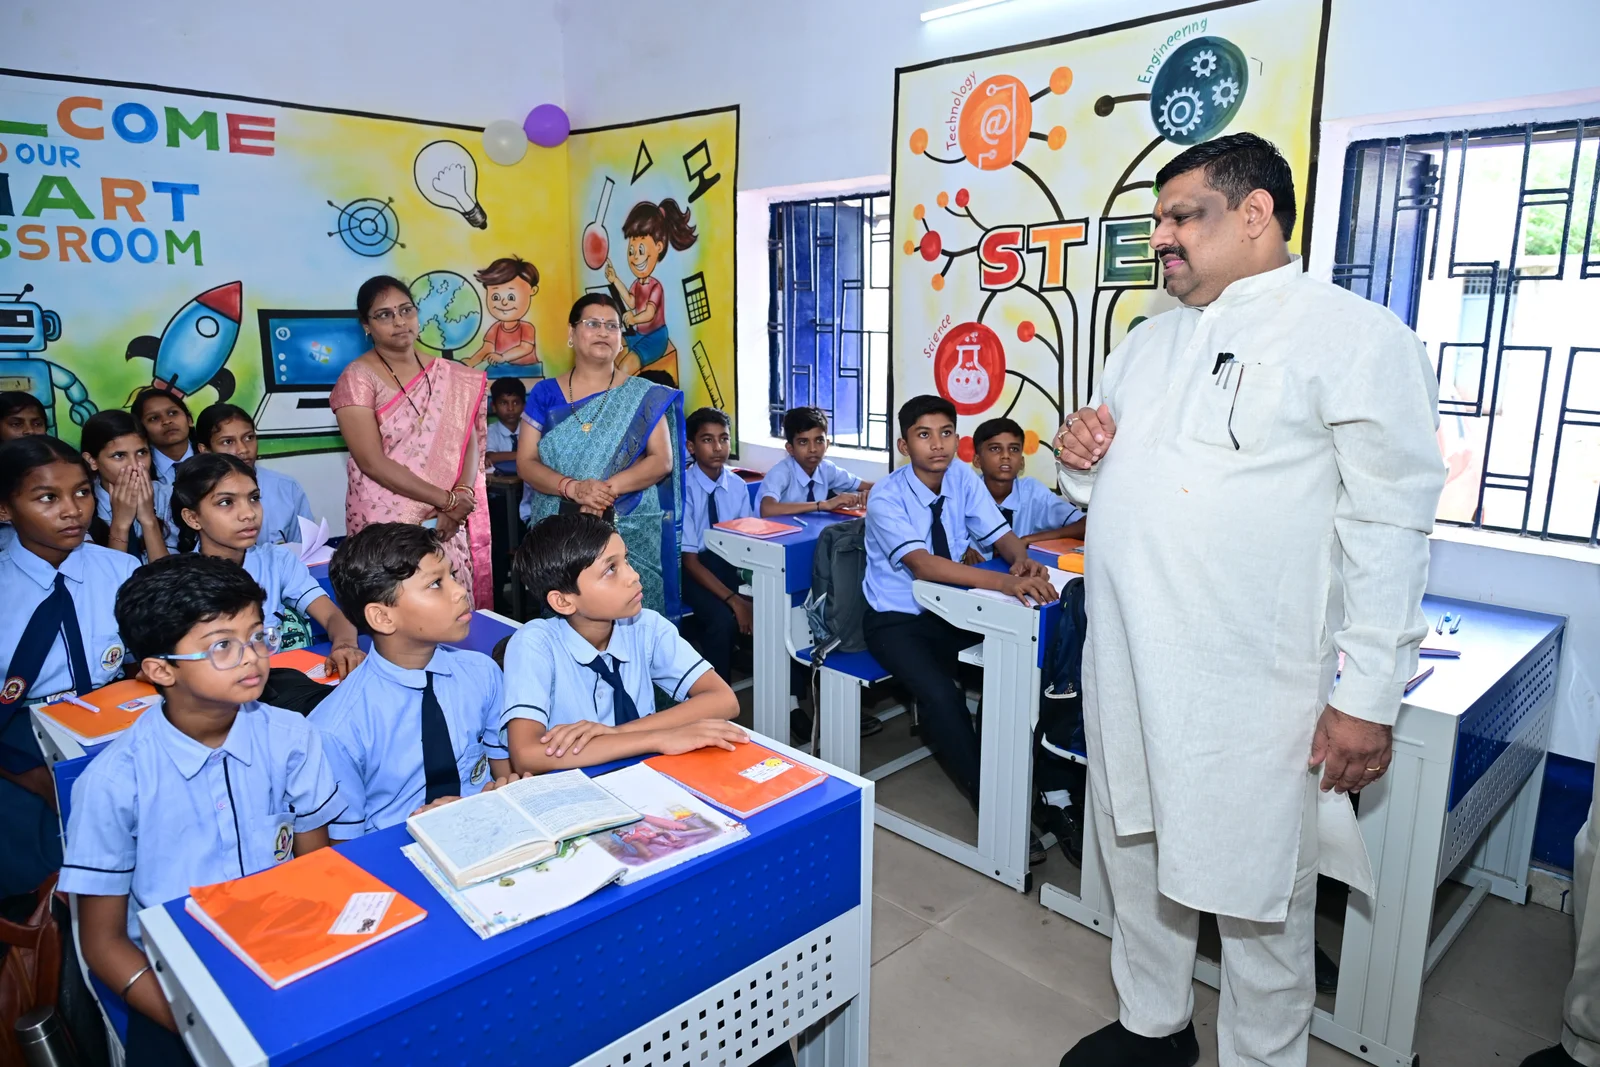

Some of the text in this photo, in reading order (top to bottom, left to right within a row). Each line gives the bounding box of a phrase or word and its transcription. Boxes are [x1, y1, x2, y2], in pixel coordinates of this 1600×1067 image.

[1137, 17, 1208, 84] Engineering
[945, 71, 977, 151] Technology
[15, 143, 81, 169] OUR
[0, 172, 200, 223] ART
[977, 215, 1168, 293] STE
[923, 313, 952, 359] Science
